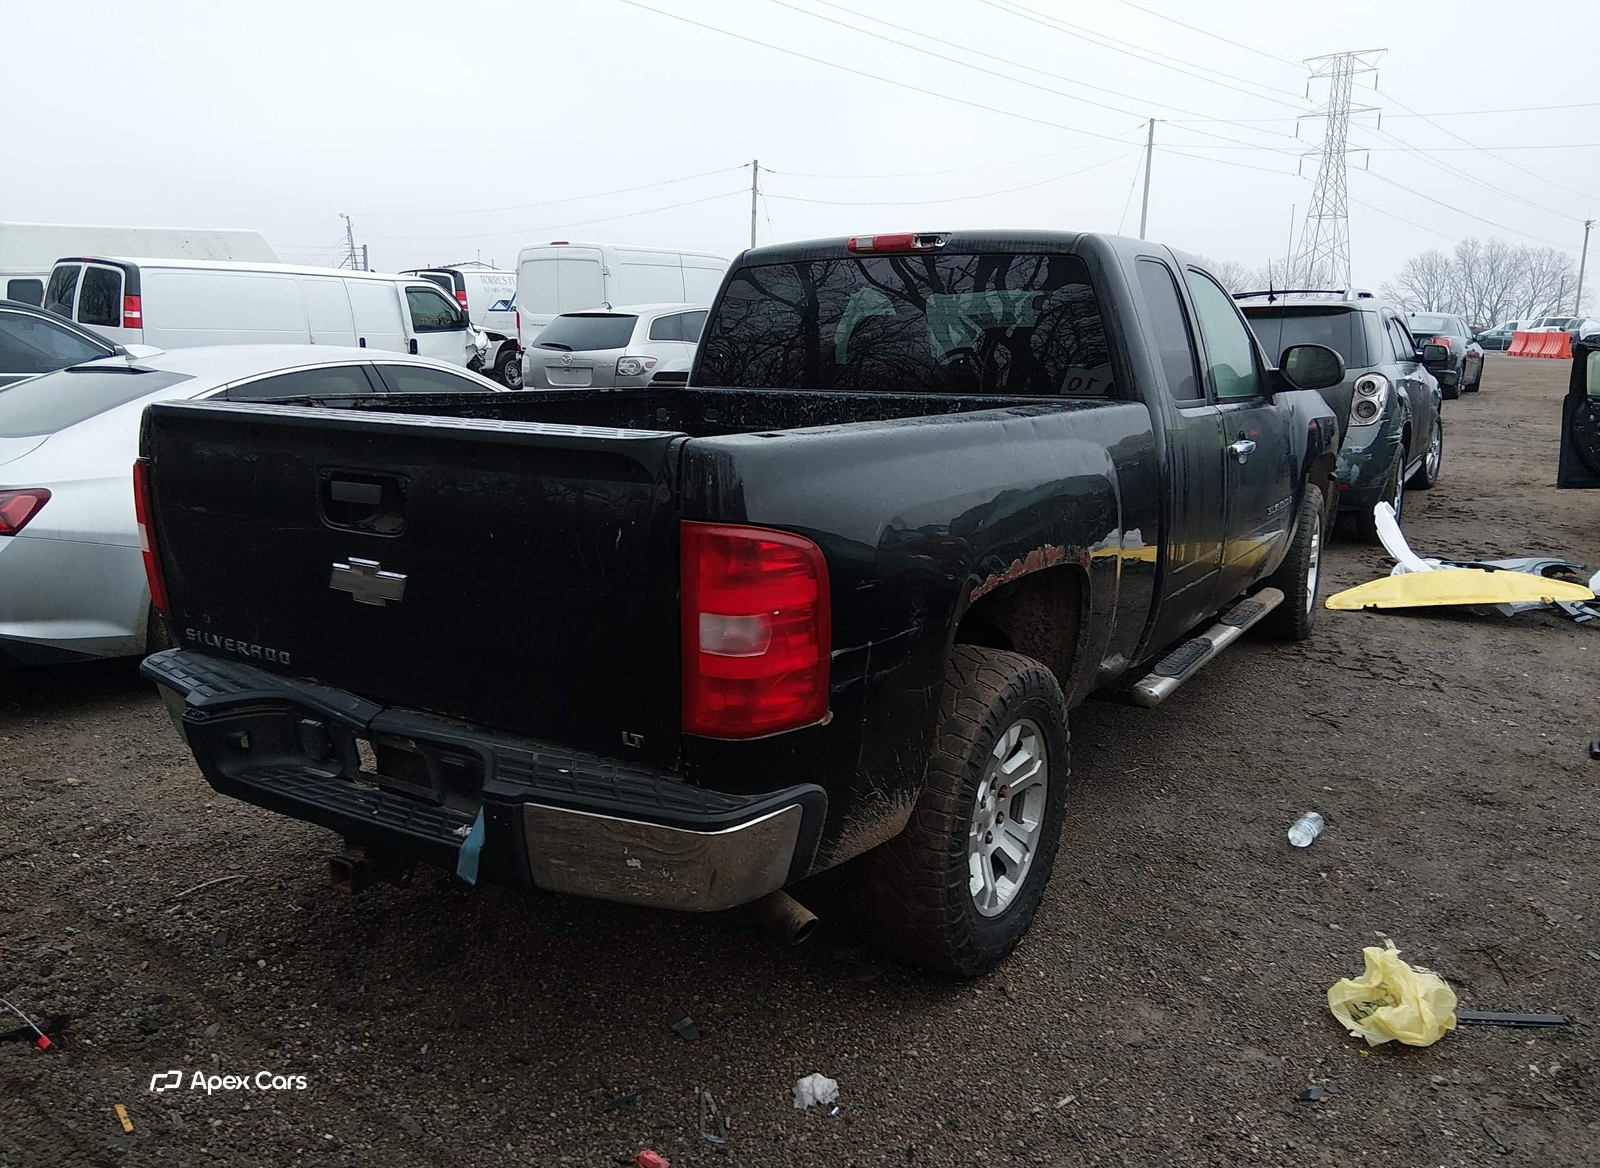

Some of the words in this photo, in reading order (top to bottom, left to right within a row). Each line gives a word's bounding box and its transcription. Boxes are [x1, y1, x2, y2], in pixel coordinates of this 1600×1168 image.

[479, 275, 507, 285] TORRES
[186, 627, 291, 665] SILVERADO
[622, 731, 644, 749] LT
